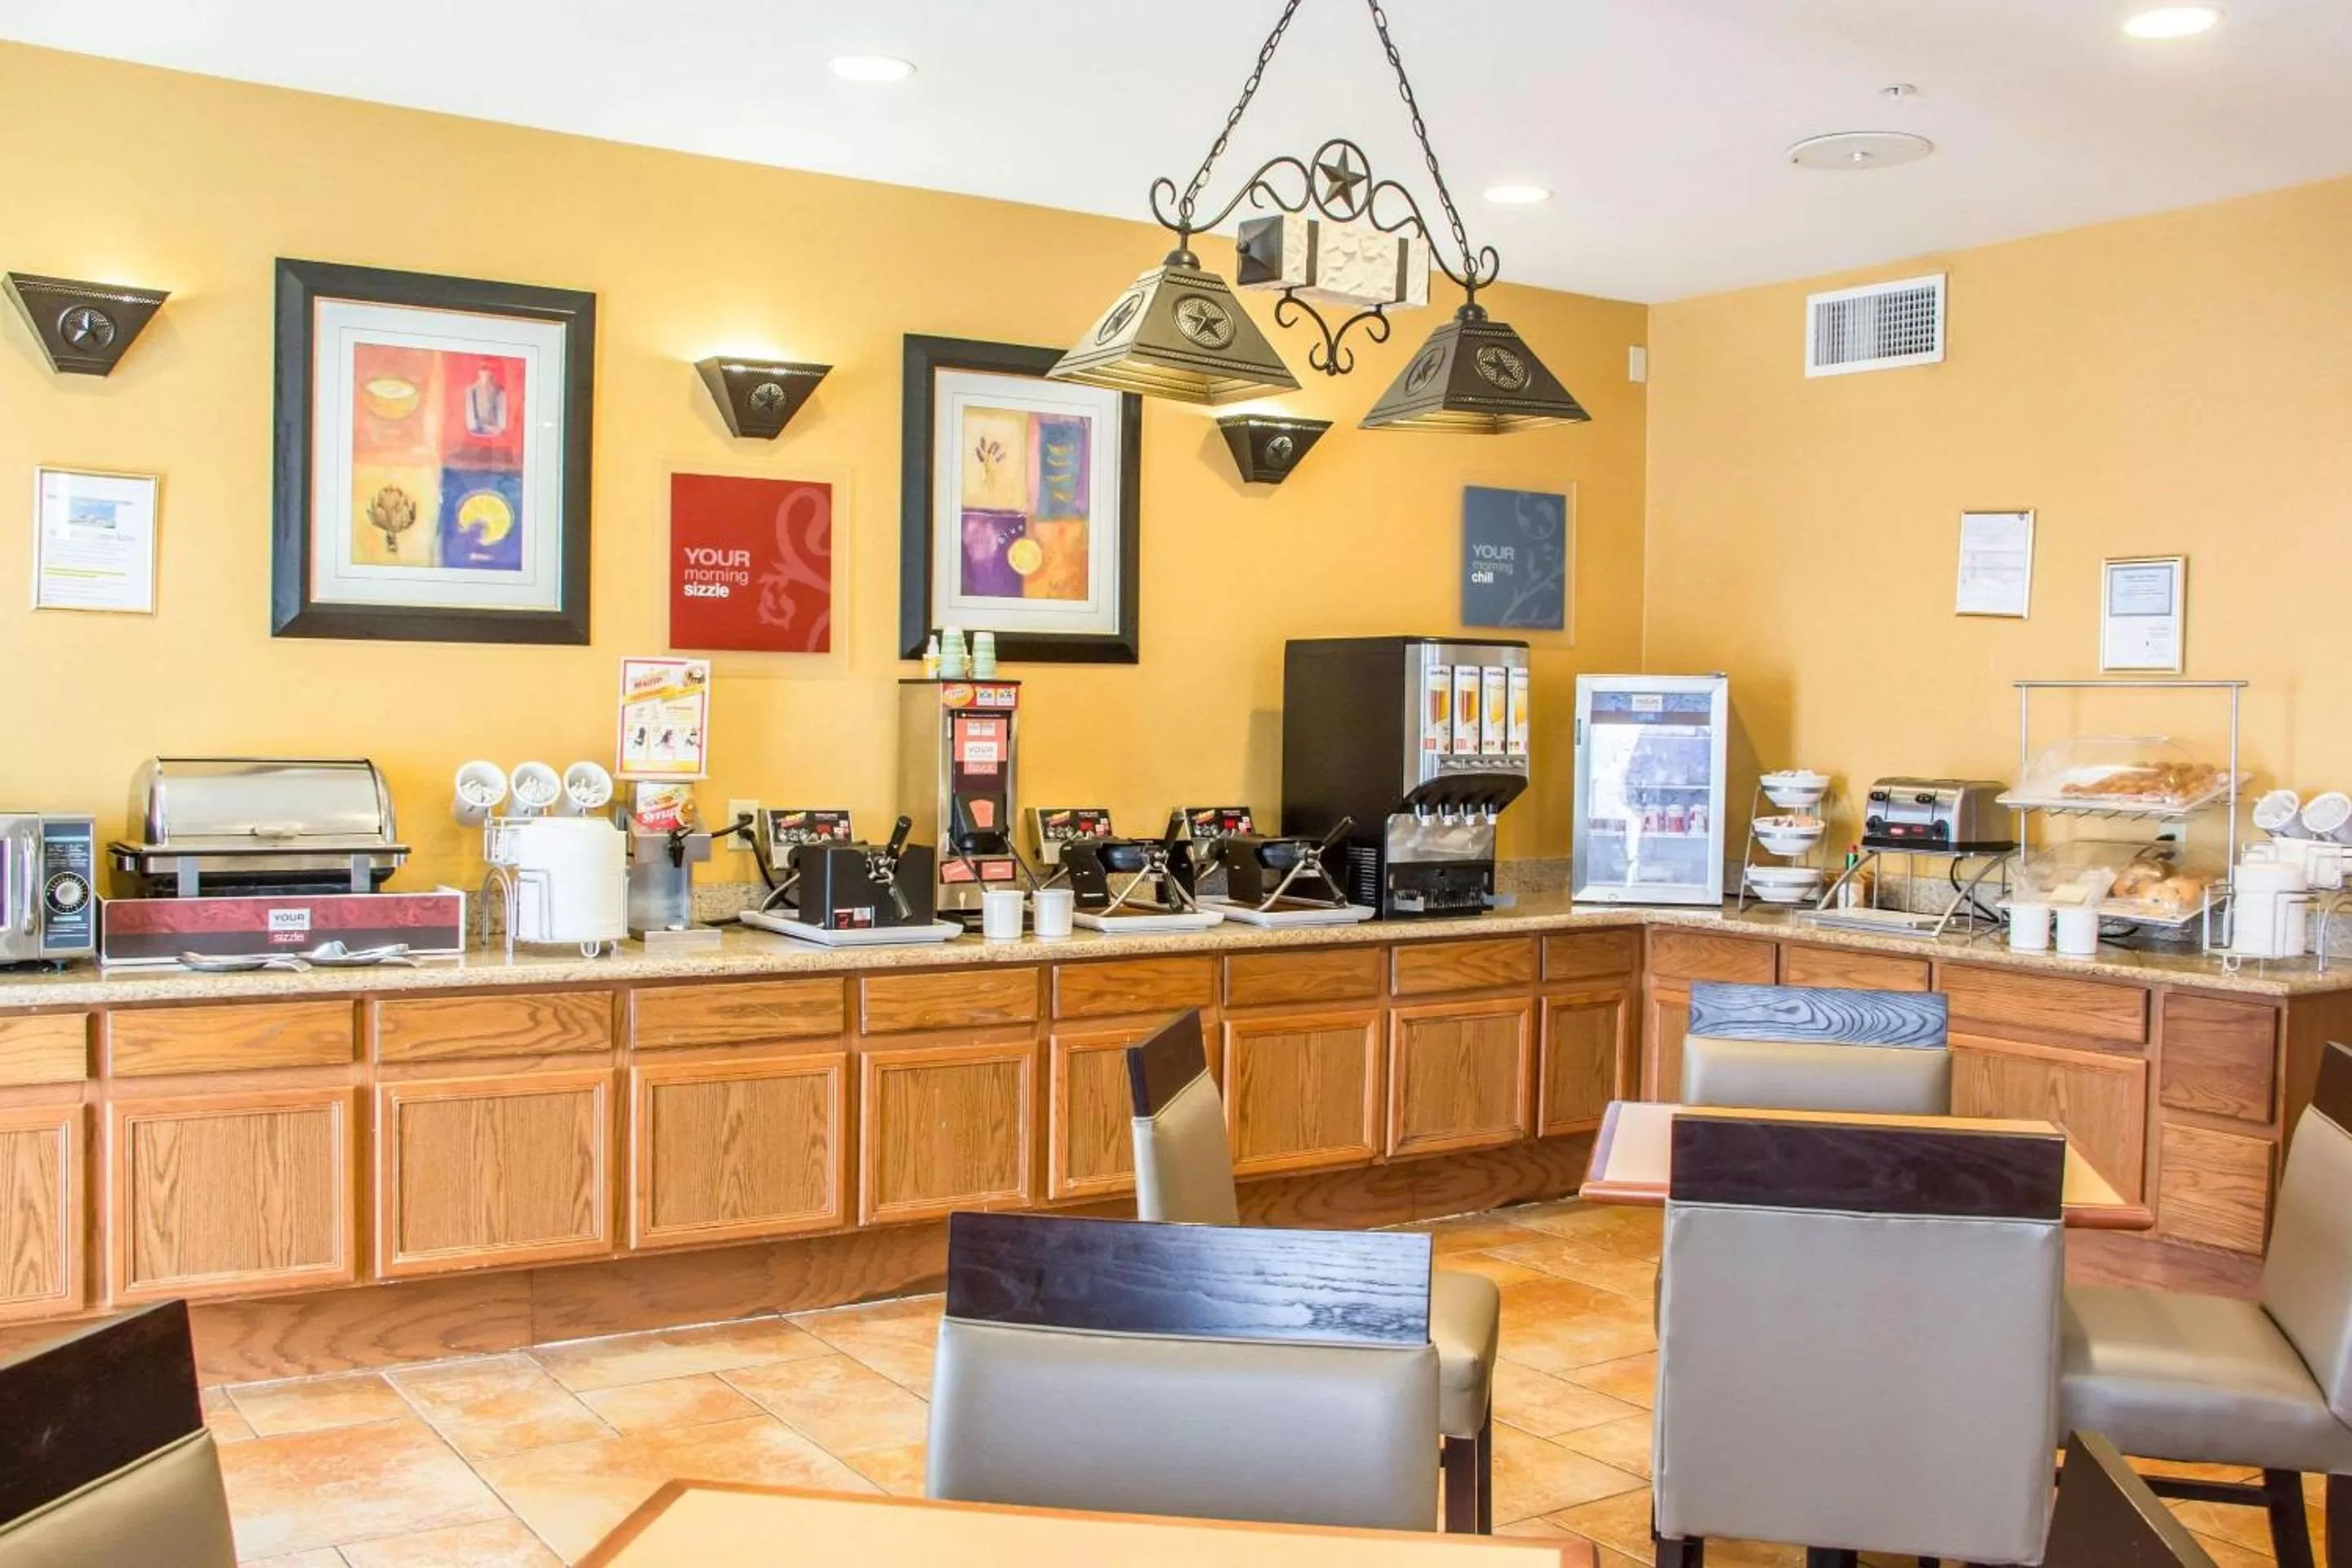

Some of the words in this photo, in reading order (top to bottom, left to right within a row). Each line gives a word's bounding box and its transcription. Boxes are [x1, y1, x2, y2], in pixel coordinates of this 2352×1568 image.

[684, 546, 751, 568] YOUR
[1472, 544, 1515, 560] YOUR
[684, 567, 749, 586] morning
[1471, 571, 1494, 583] chill
[684, 581, 729, 598] sizzle
[273, 913, 305, 922] YOUR
